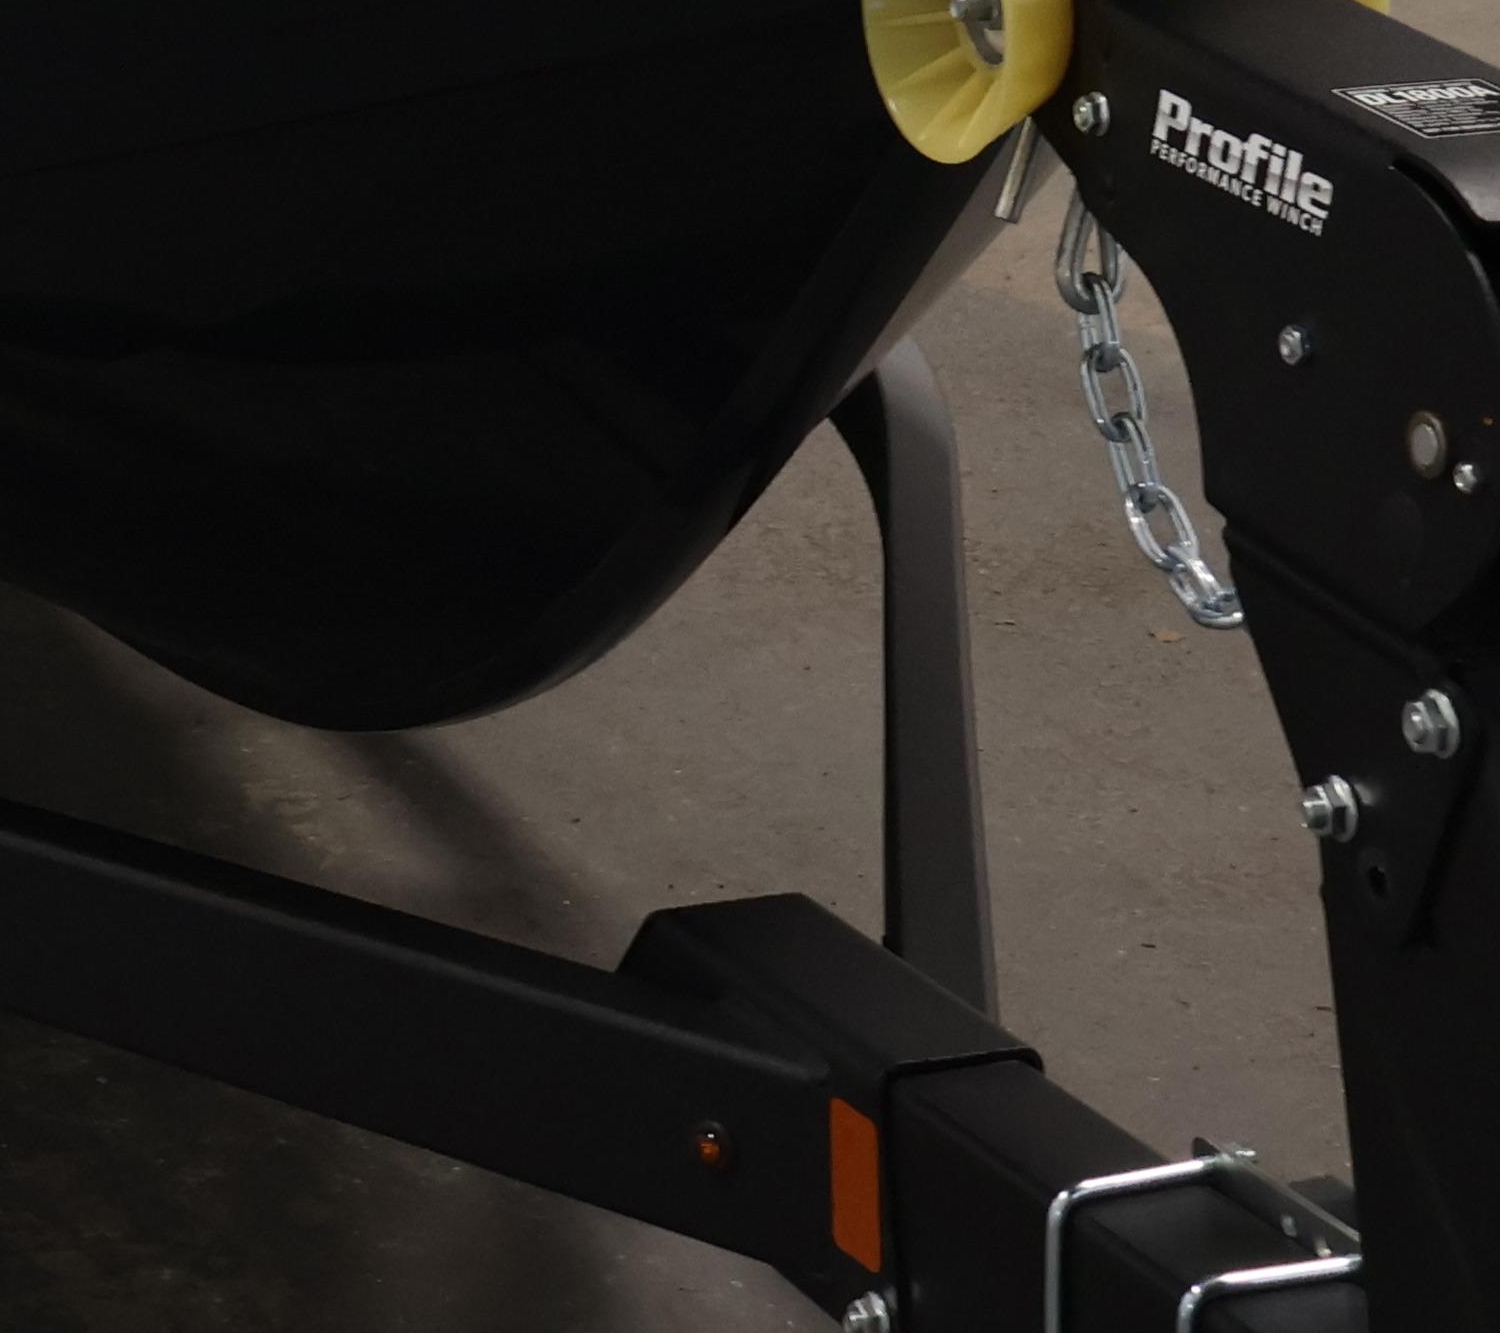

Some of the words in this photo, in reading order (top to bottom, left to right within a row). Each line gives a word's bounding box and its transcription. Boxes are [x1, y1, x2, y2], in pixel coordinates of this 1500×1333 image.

[1150, 138, 1264, 207] PERFORMANCE
[1266, 194, 1324, 236] WINCH
[1152, 89, 1334, 219] Profile
